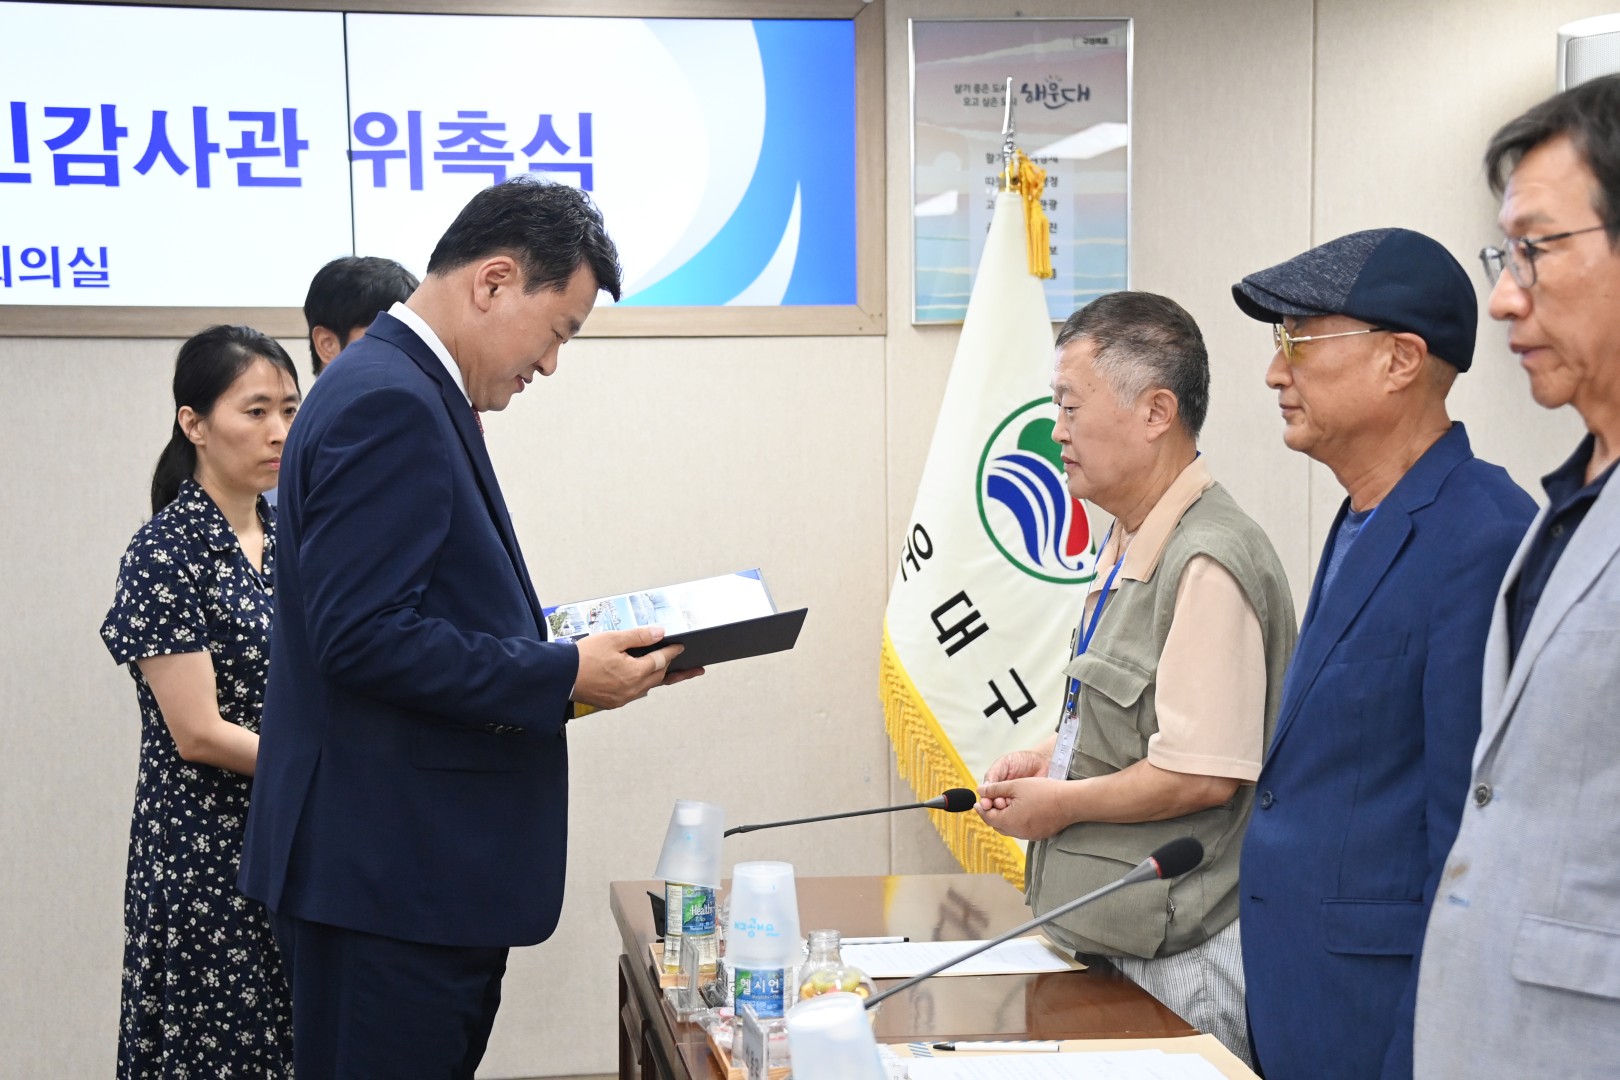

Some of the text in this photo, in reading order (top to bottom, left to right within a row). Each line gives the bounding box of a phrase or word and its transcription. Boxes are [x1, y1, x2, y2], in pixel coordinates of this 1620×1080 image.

[954, 83, 970, 94] 살기
[1020, 82, 1090, 110] 해운대
[347, 110, 595, 191] 위촉식
[740, 978, 780, 995] 헬시언
